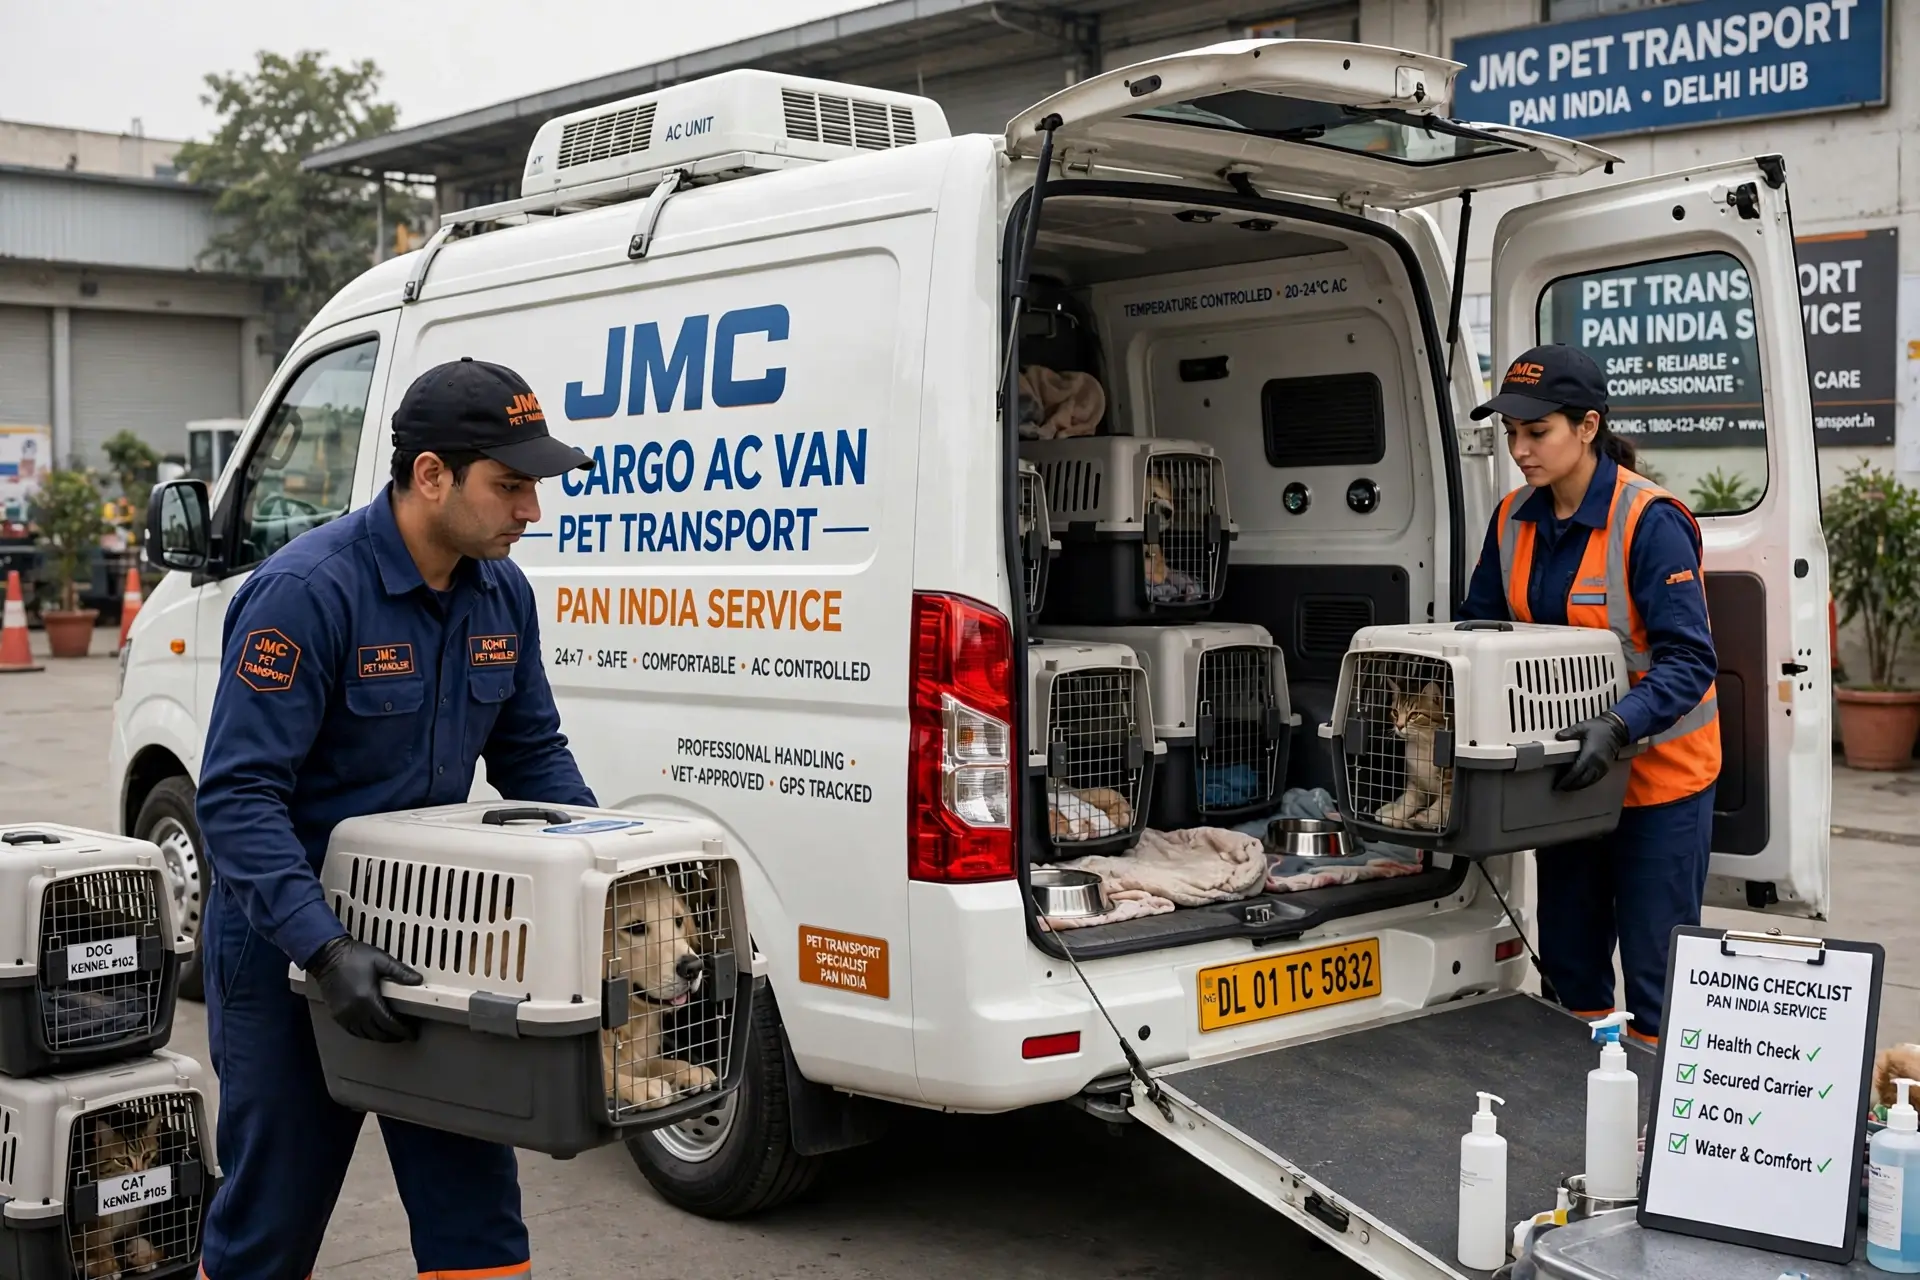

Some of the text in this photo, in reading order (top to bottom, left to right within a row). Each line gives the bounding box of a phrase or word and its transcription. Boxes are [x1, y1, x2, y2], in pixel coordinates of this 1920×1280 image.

[1470, 0, 1859, 93] JMC PET TRANSPORT
[1509, 61, 1809, 127] PAN INDIA DELHI HUB
[665, 116, 714, 142] AC UNIT
[1124, 296, 1198, 317] TEMPERATURE
[1200, 287, 1272, 309] CONTROLLED
[1332, 278, 1347, 293] AC
[1582, 277, 1638, 310] PET
[1582, 316, 1638, 347] PAN
[1646, 310, 1728, 344] INDIA
[564, 304, 790, 421] JMC
[1606, 353, 1727, 375] SAFE RELIABLE
[1607, 370, 1861, 396] COMPASSIONATE CARE
[1648, 416, 1725, 433] 1800-123-4567
[561, 428, 868, 497] CARGO AC VAN
[559, 508, 818, 553] PET TRANSPORT
[557, 587, 842, 632] PAN INDIA SERVICE
[254, 636, 289, 657] JMC
[375, 649, 396, 661] JMC
[244, 661, 290, 684] TRANSPORT
[258, 654, 275, 667] PET
[363, 660, 410, 673] PET HANDLER
[597, 649, 628, 669] SAFE
[642, 652, 736, 675] COMFORTABLE
[751, 658, 770, 677] AC
[774, 659, 870, 682] CONTROLLED
[677, 737, 845, 771] PROFESSIONAL HANDLING
[779, 776, 805, 796] GPS
[809, 779, 872, 803] TRACKED
[86, 943, 113, 958] DOG
[806, 934, 881, 959] PET TRANSPORT
[71, 956, 134, 974] KENNEL #102
[816, 952, 868, 973] SPECIALIST
[820, 969, 867, 990] PAN INDIA
[1218, 951, 1374, 1018] DL 01 TC 5832
[1690, 969, 1852, 1002] LOADING CHECKLIST
[1706, 994, 1827, 1020] PAN INDIA SERVICE
[1707, 1033, 1801, 1061] Health Check
[1703, 1068, 1813, 1099] Secured Carrier
[1698, 1104, 1743, 1125] AC On
[1695, 1138, 1813, 1173] Water & Comfort
[121, 1175, 146, 1191] CAT
[103, 1185, 167, 1209] KENNEL #105
